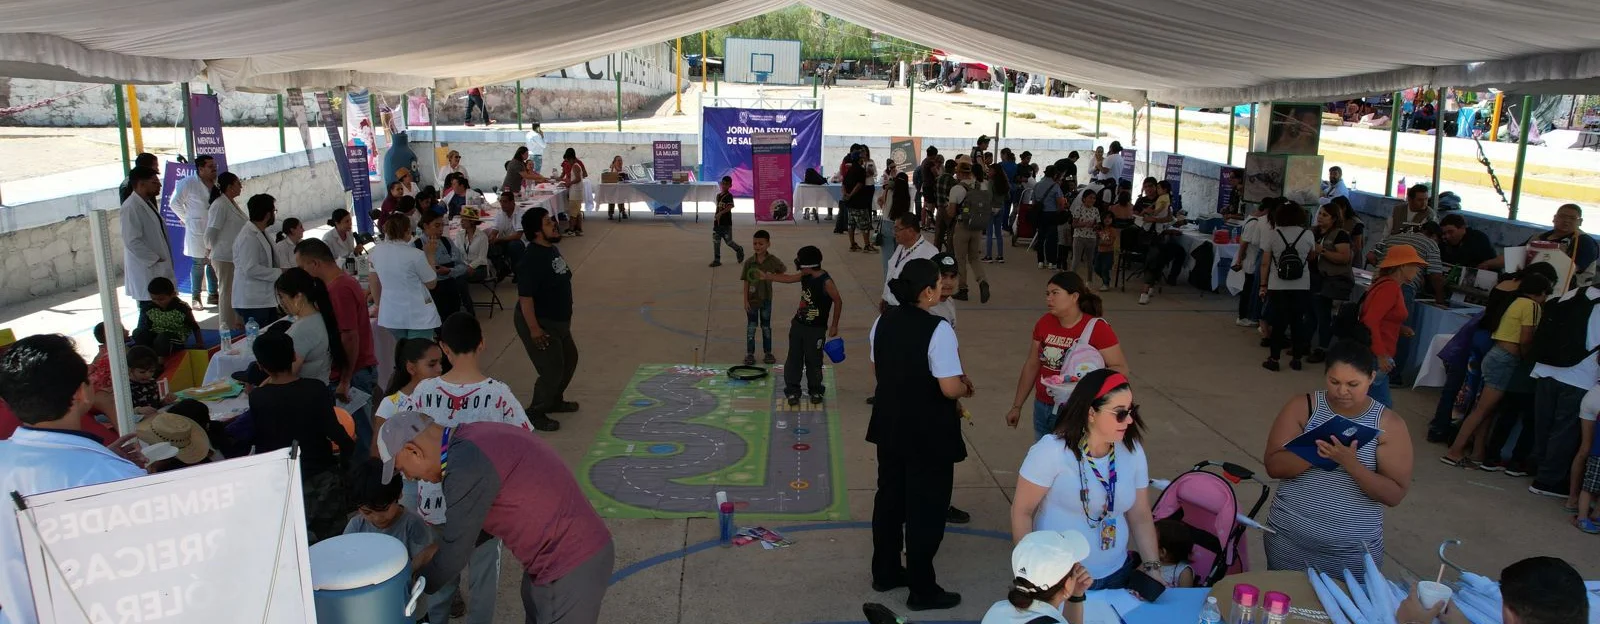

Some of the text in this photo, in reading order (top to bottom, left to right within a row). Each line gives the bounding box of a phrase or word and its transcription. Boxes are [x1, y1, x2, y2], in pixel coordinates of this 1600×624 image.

[200, 127, 215, 135] SALUD
[726, 126, 797, 136] JORNADA ESTATAL
[197, 137, 214, 145] MENTAL
[727, 137, 737, 145] DE
[738, 137, 752, 145] SAL
[176, 167, 198, 178] SALU
[1045, 333, 1074, 348] WRANGLER
